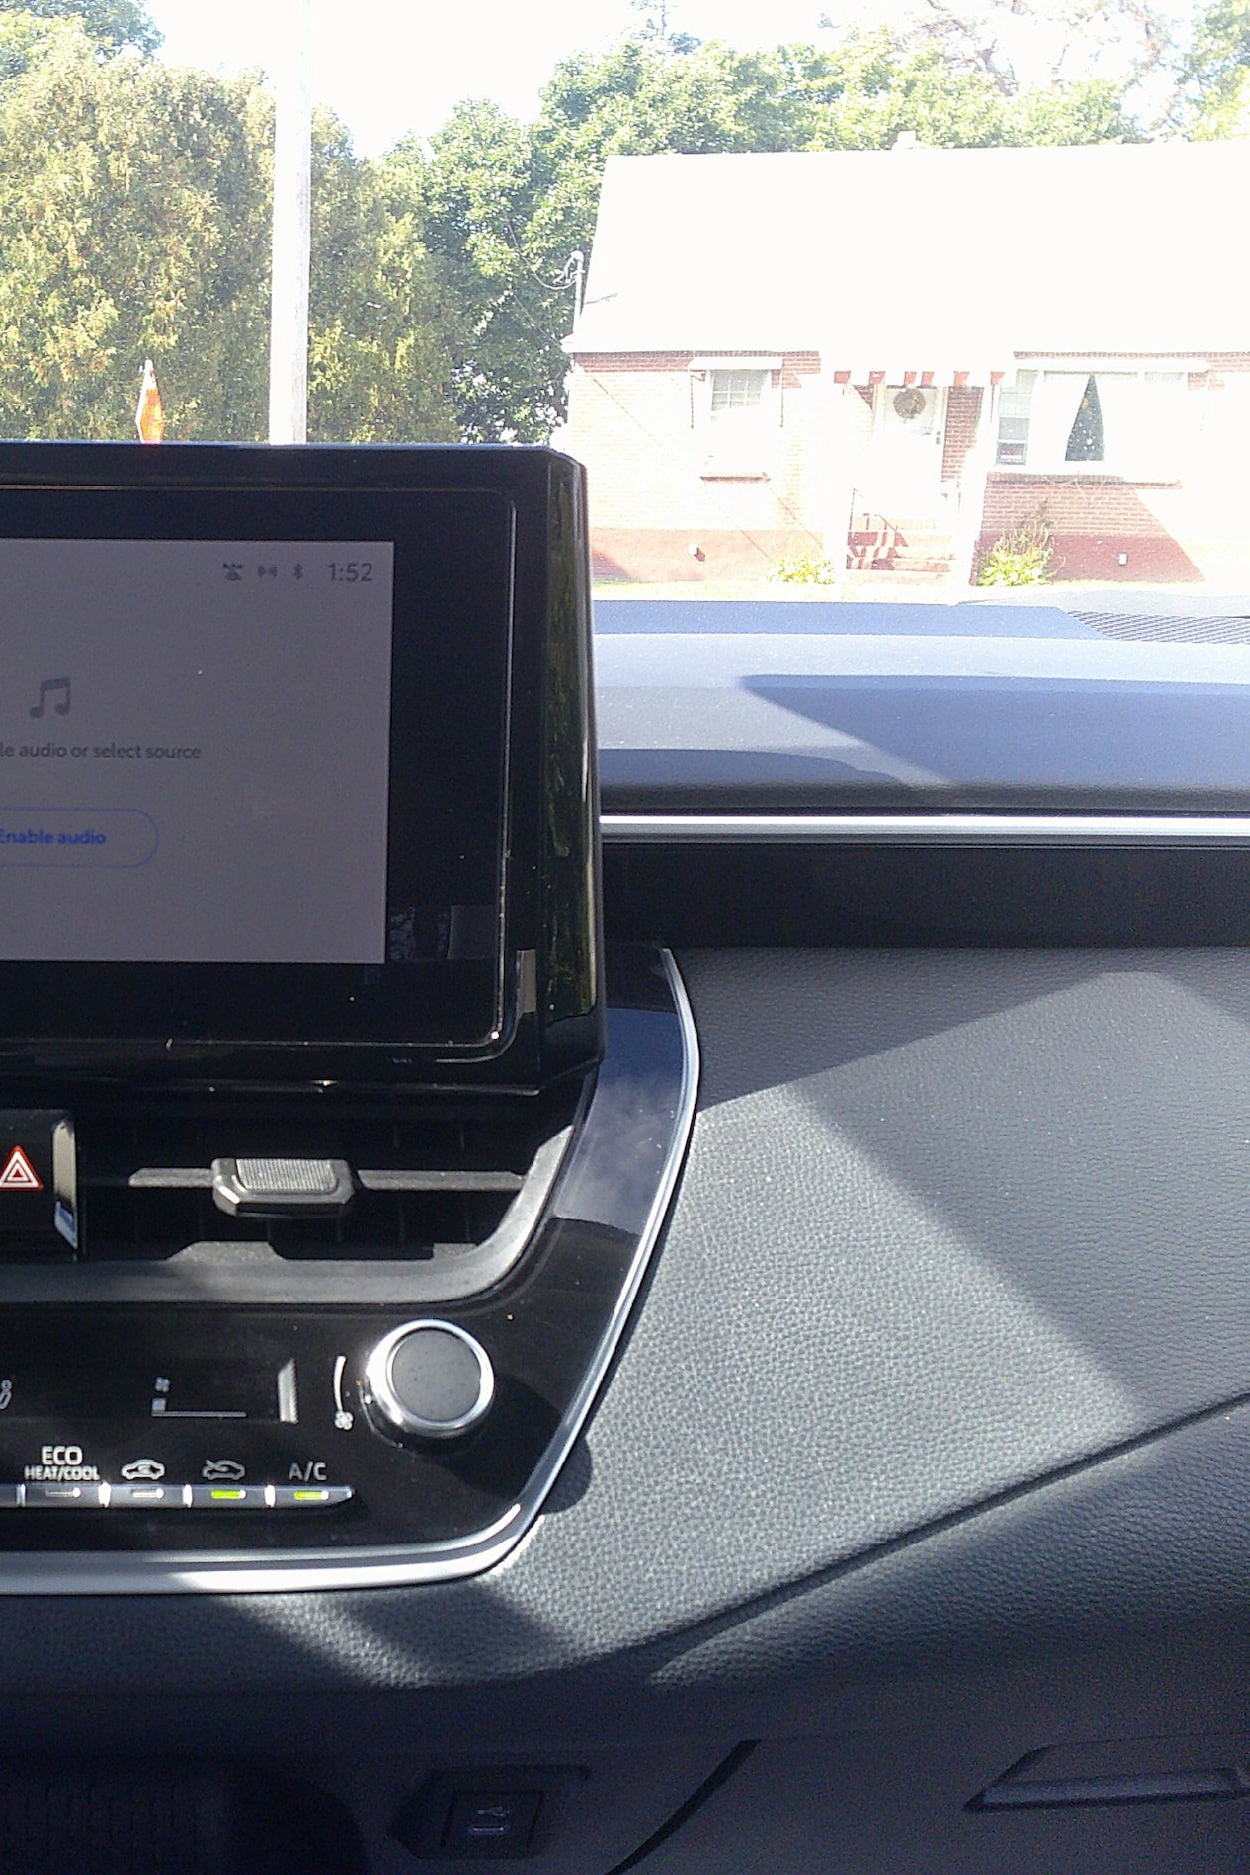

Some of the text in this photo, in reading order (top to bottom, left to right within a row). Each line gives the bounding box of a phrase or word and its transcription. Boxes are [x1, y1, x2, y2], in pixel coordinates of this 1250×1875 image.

[328, 562, 373, 582] 1:52
[19, 741, 68, 758] audio
[71, 746, 88, 758] or
[93, 741, 141, 759] select
[145, 747, 202, 759] source
[58, 829, 106, 844] audio
[41, 1447, 83, 1466] ECO
[24, 1465, 99, 1482] HEAT/COOL
[288, 1462, 327, 1481] A/C
